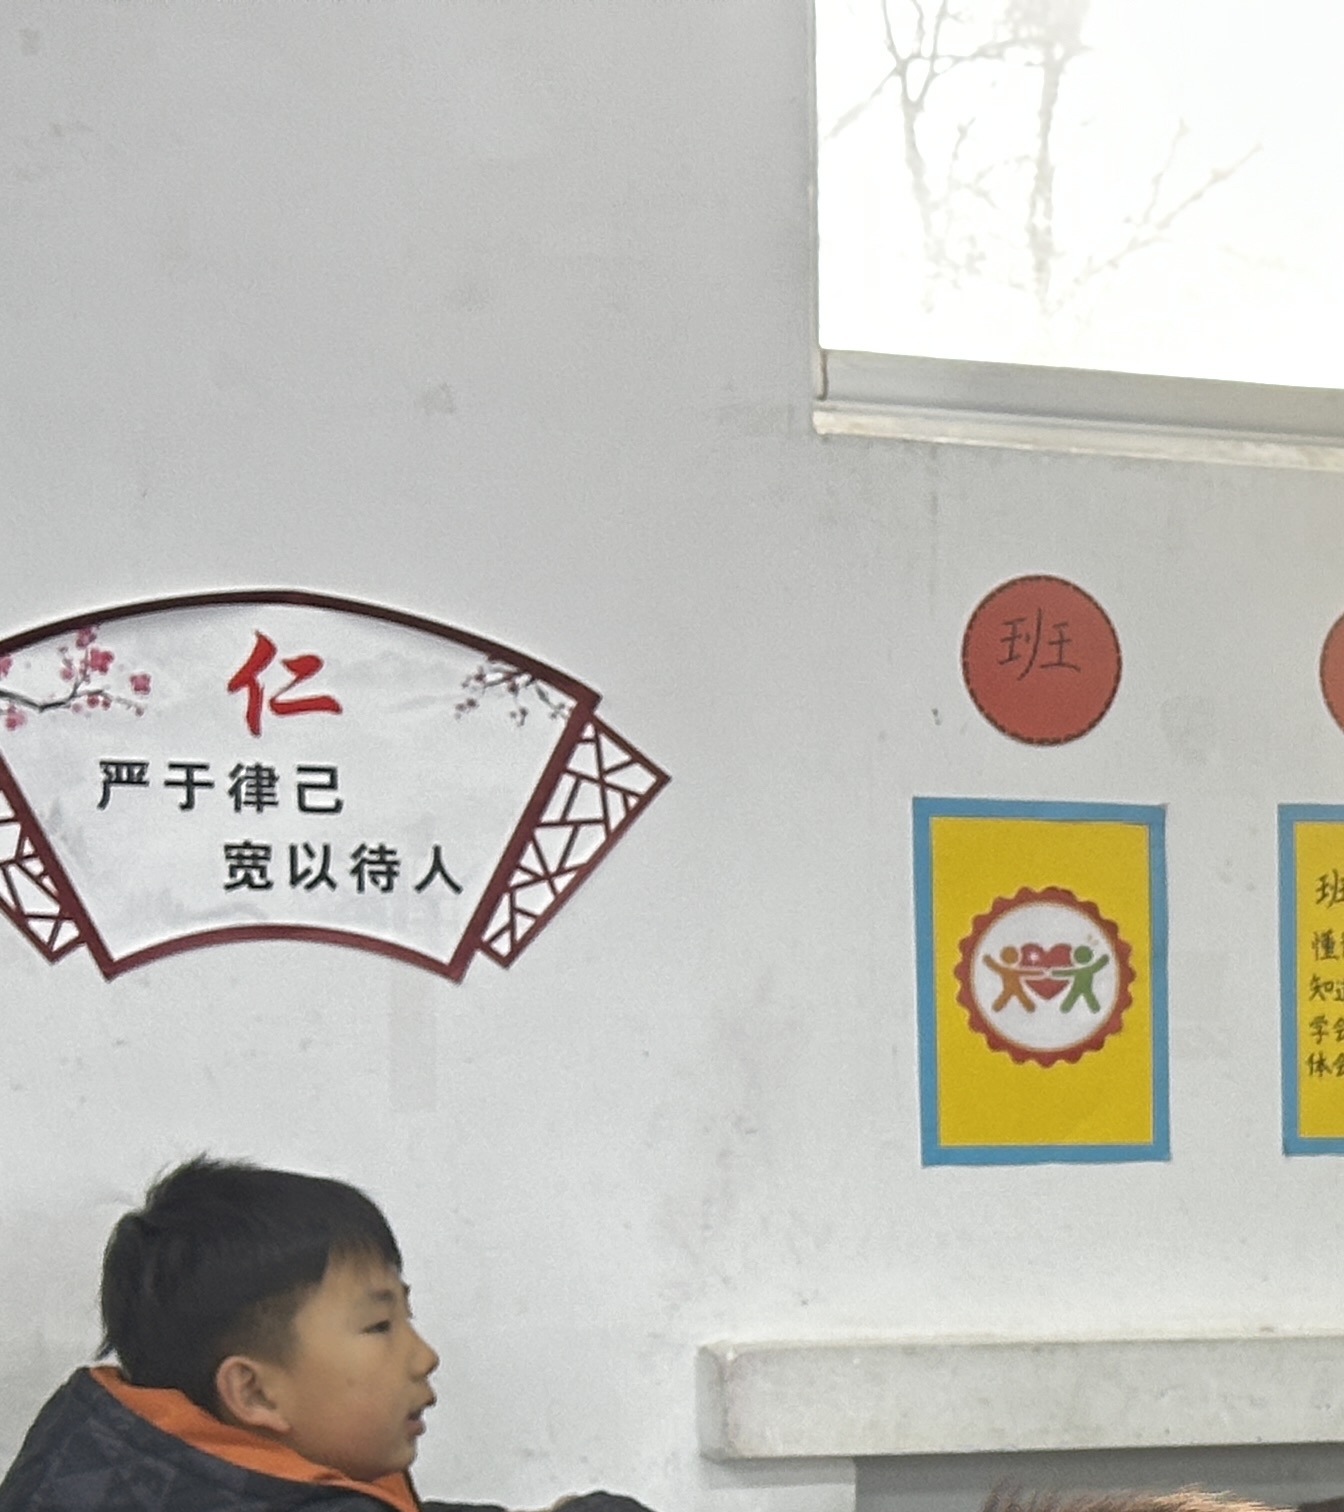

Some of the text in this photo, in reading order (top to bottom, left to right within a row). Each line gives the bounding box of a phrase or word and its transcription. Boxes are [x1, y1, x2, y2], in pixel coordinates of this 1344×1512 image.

[998, 607, 1083, 681] 班
[227, 630, 343, 738] 仁
[97, 760, 346, 816] 严于律己
[222, 840, 464, 895] 宽以待人
